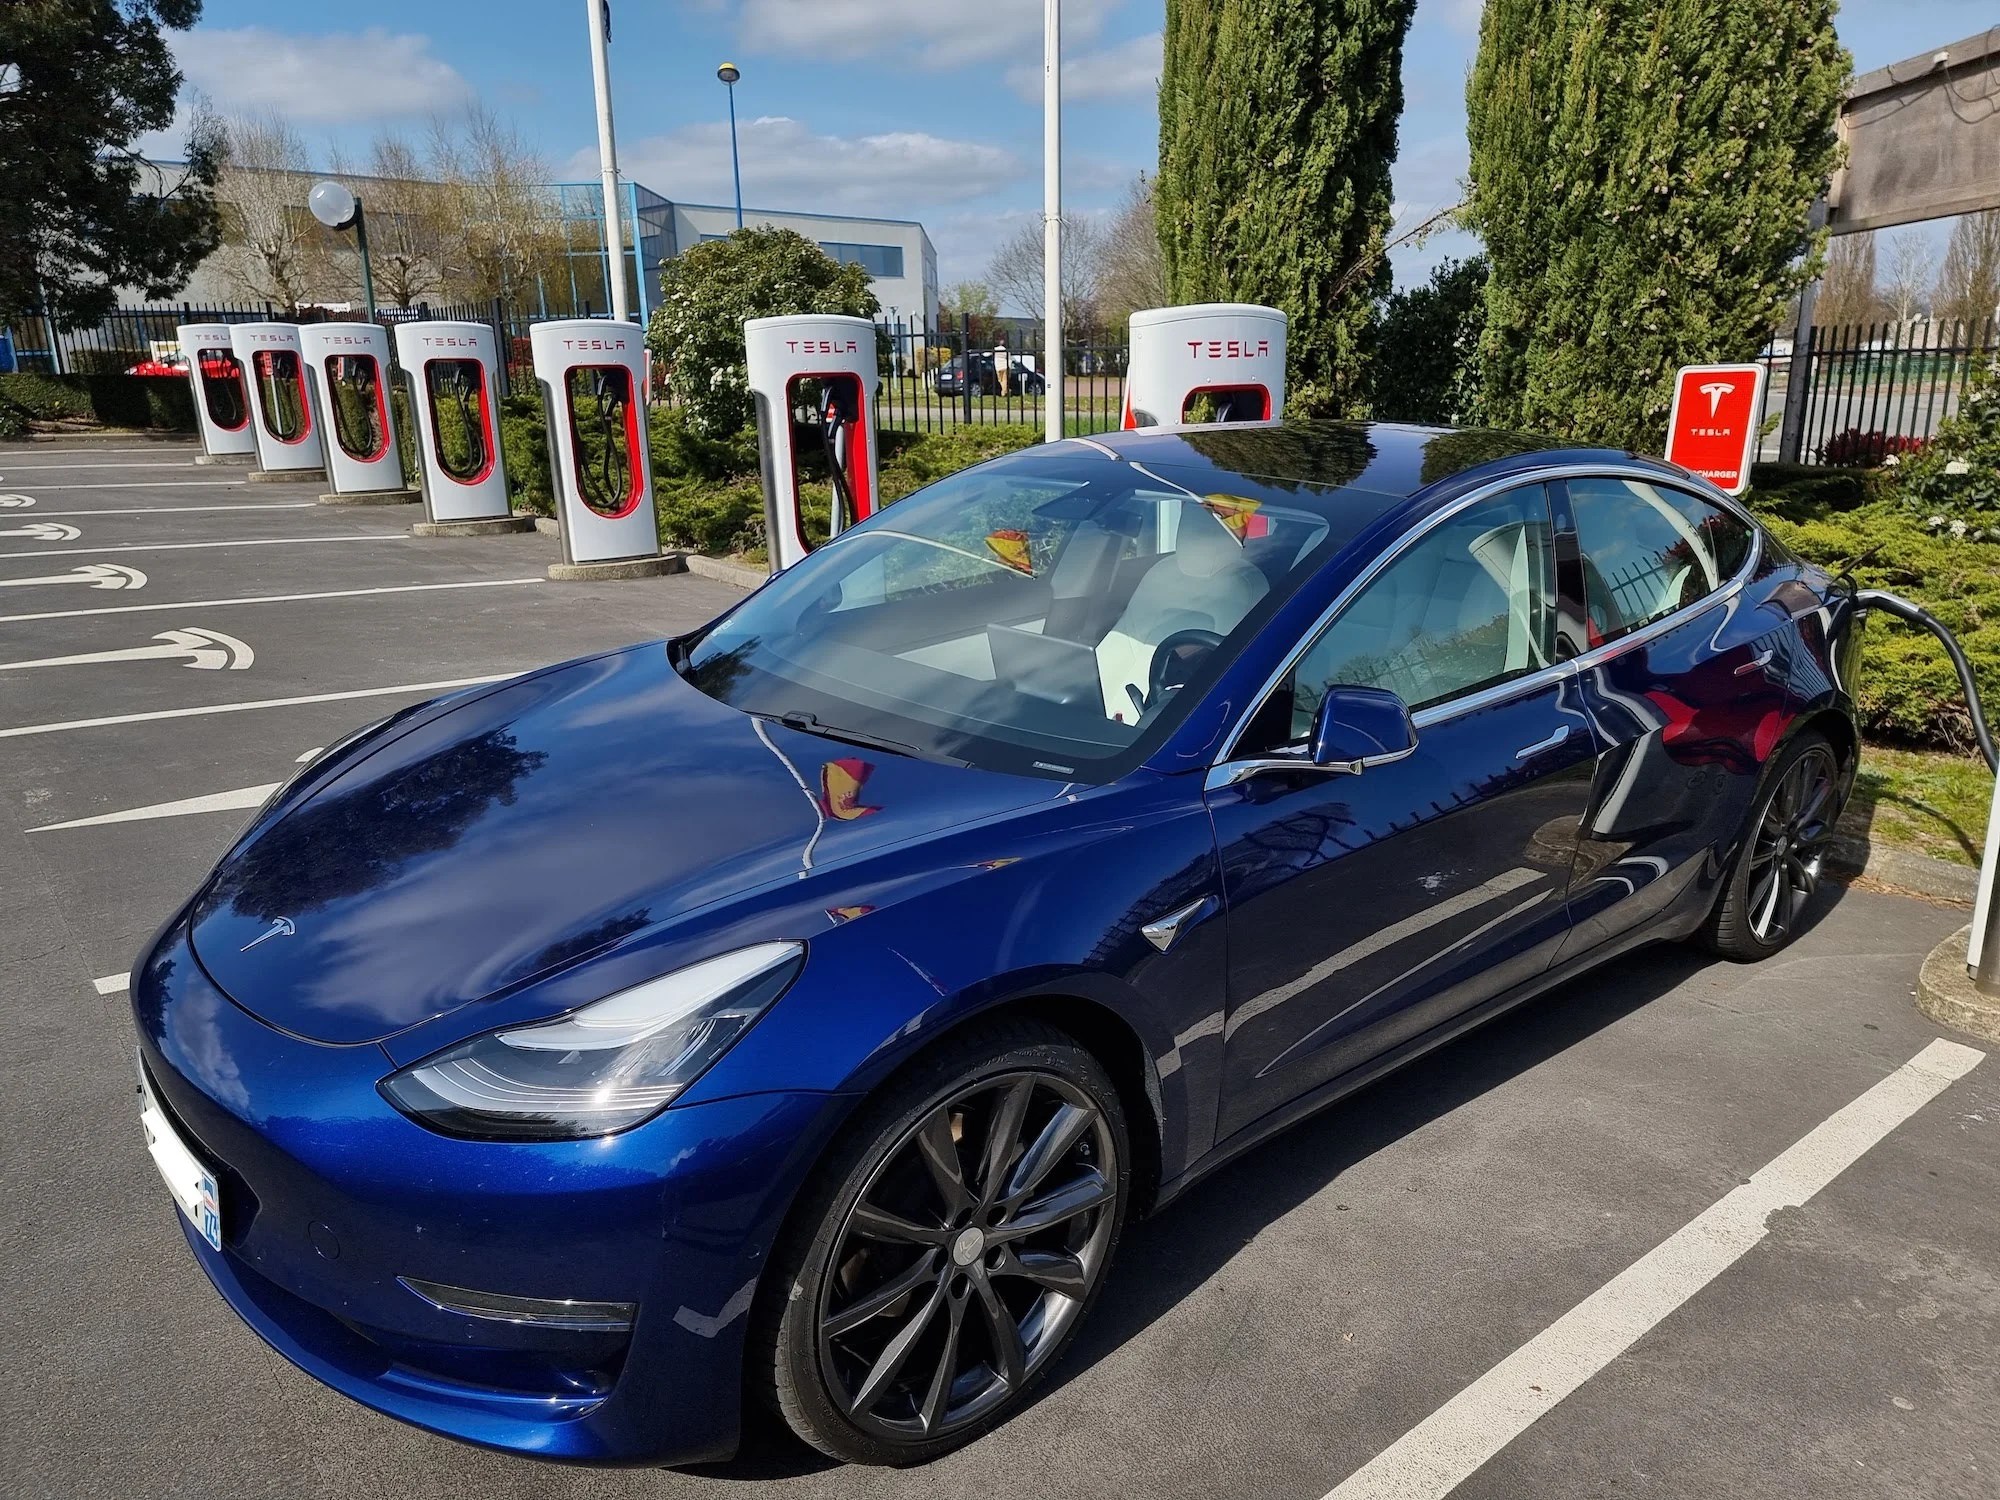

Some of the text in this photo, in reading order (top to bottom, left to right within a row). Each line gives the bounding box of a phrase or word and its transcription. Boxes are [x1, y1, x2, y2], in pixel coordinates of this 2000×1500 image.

[250, 334, 294, 342] TESLA
[322, 336, 372, 345] TESLA
[422, 337, 478, 347] TESLA
[562, 340, 625, 350] TESLA
[785, 341, 857, 353] TESLA
[1187, 340, 1268, 358] TESLA
[1690, 428, 1731, 436] TESLA
[1693, 470, 1738, 479] HARGER
